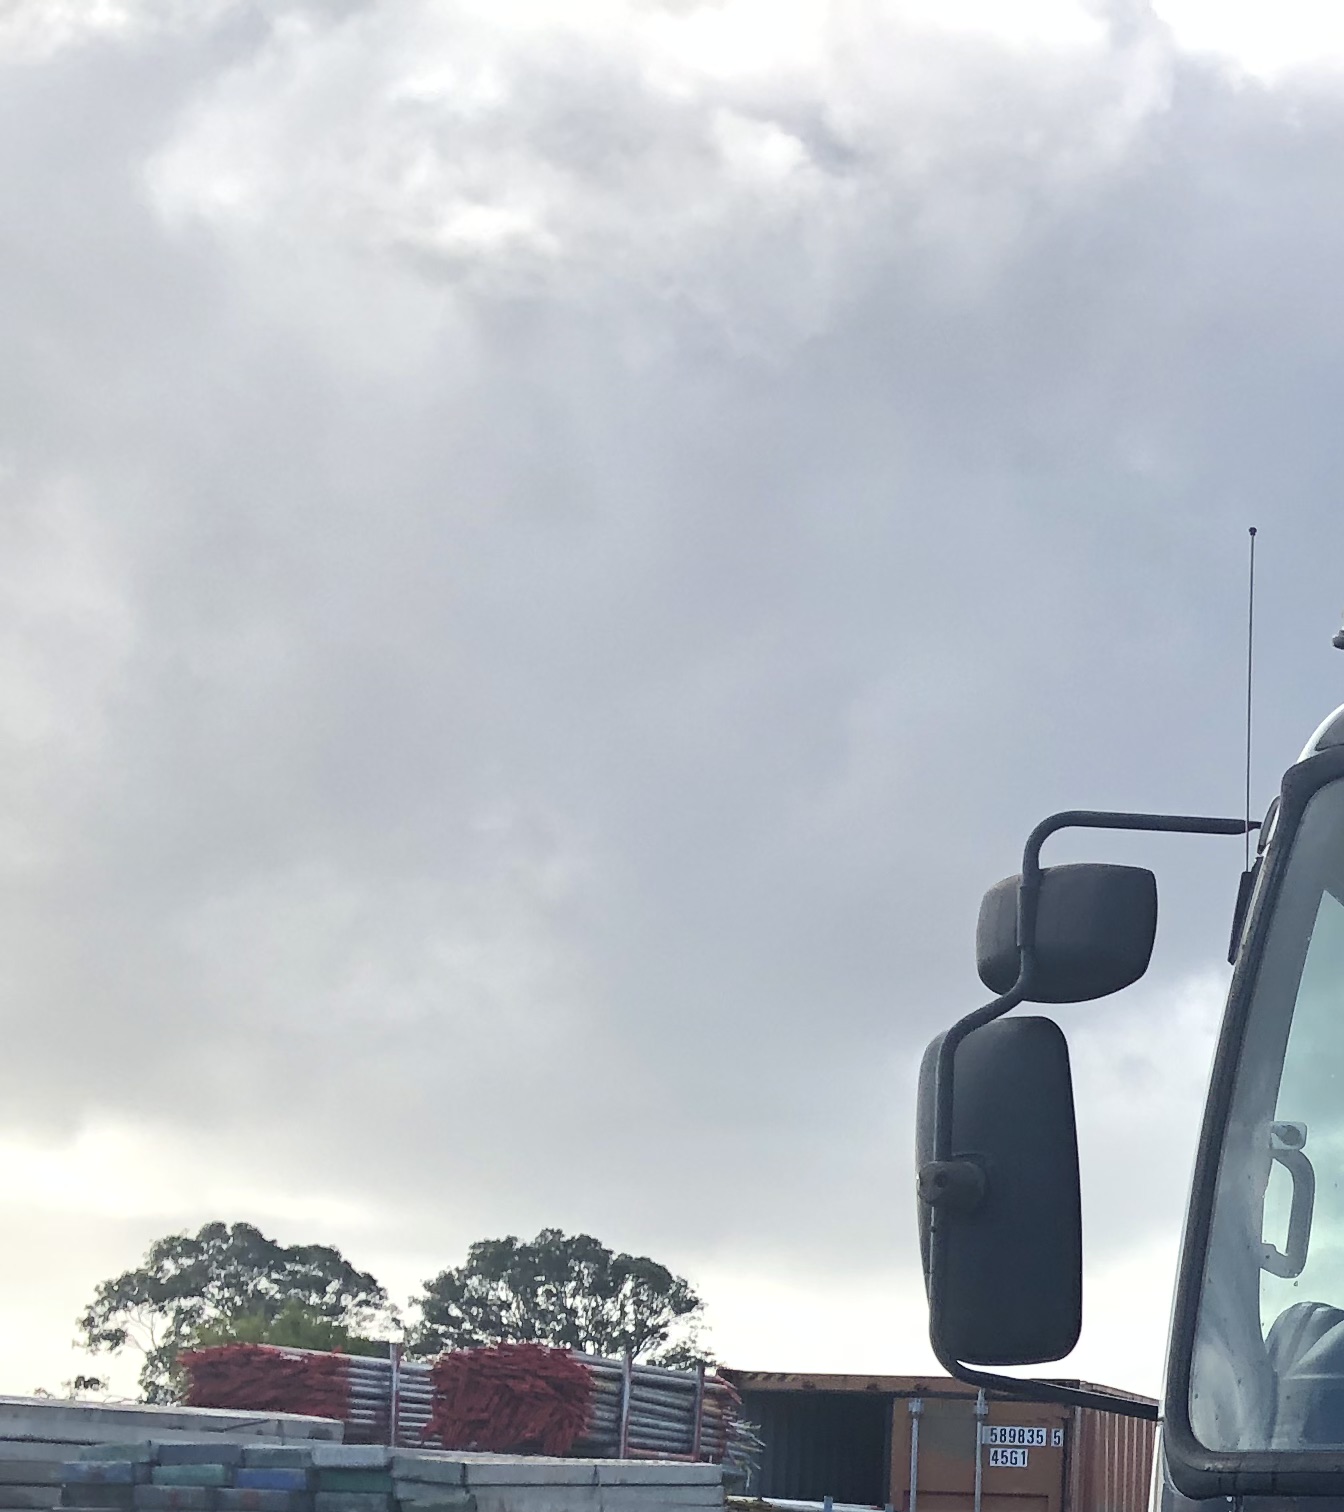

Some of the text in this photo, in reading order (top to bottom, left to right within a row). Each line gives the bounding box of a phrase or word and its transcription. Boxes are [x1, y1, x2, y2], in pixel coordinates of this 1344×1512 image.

[990, 1427, 1061, 1445] 589835 5
[991, 1449, 1026, 1465] 45G1
